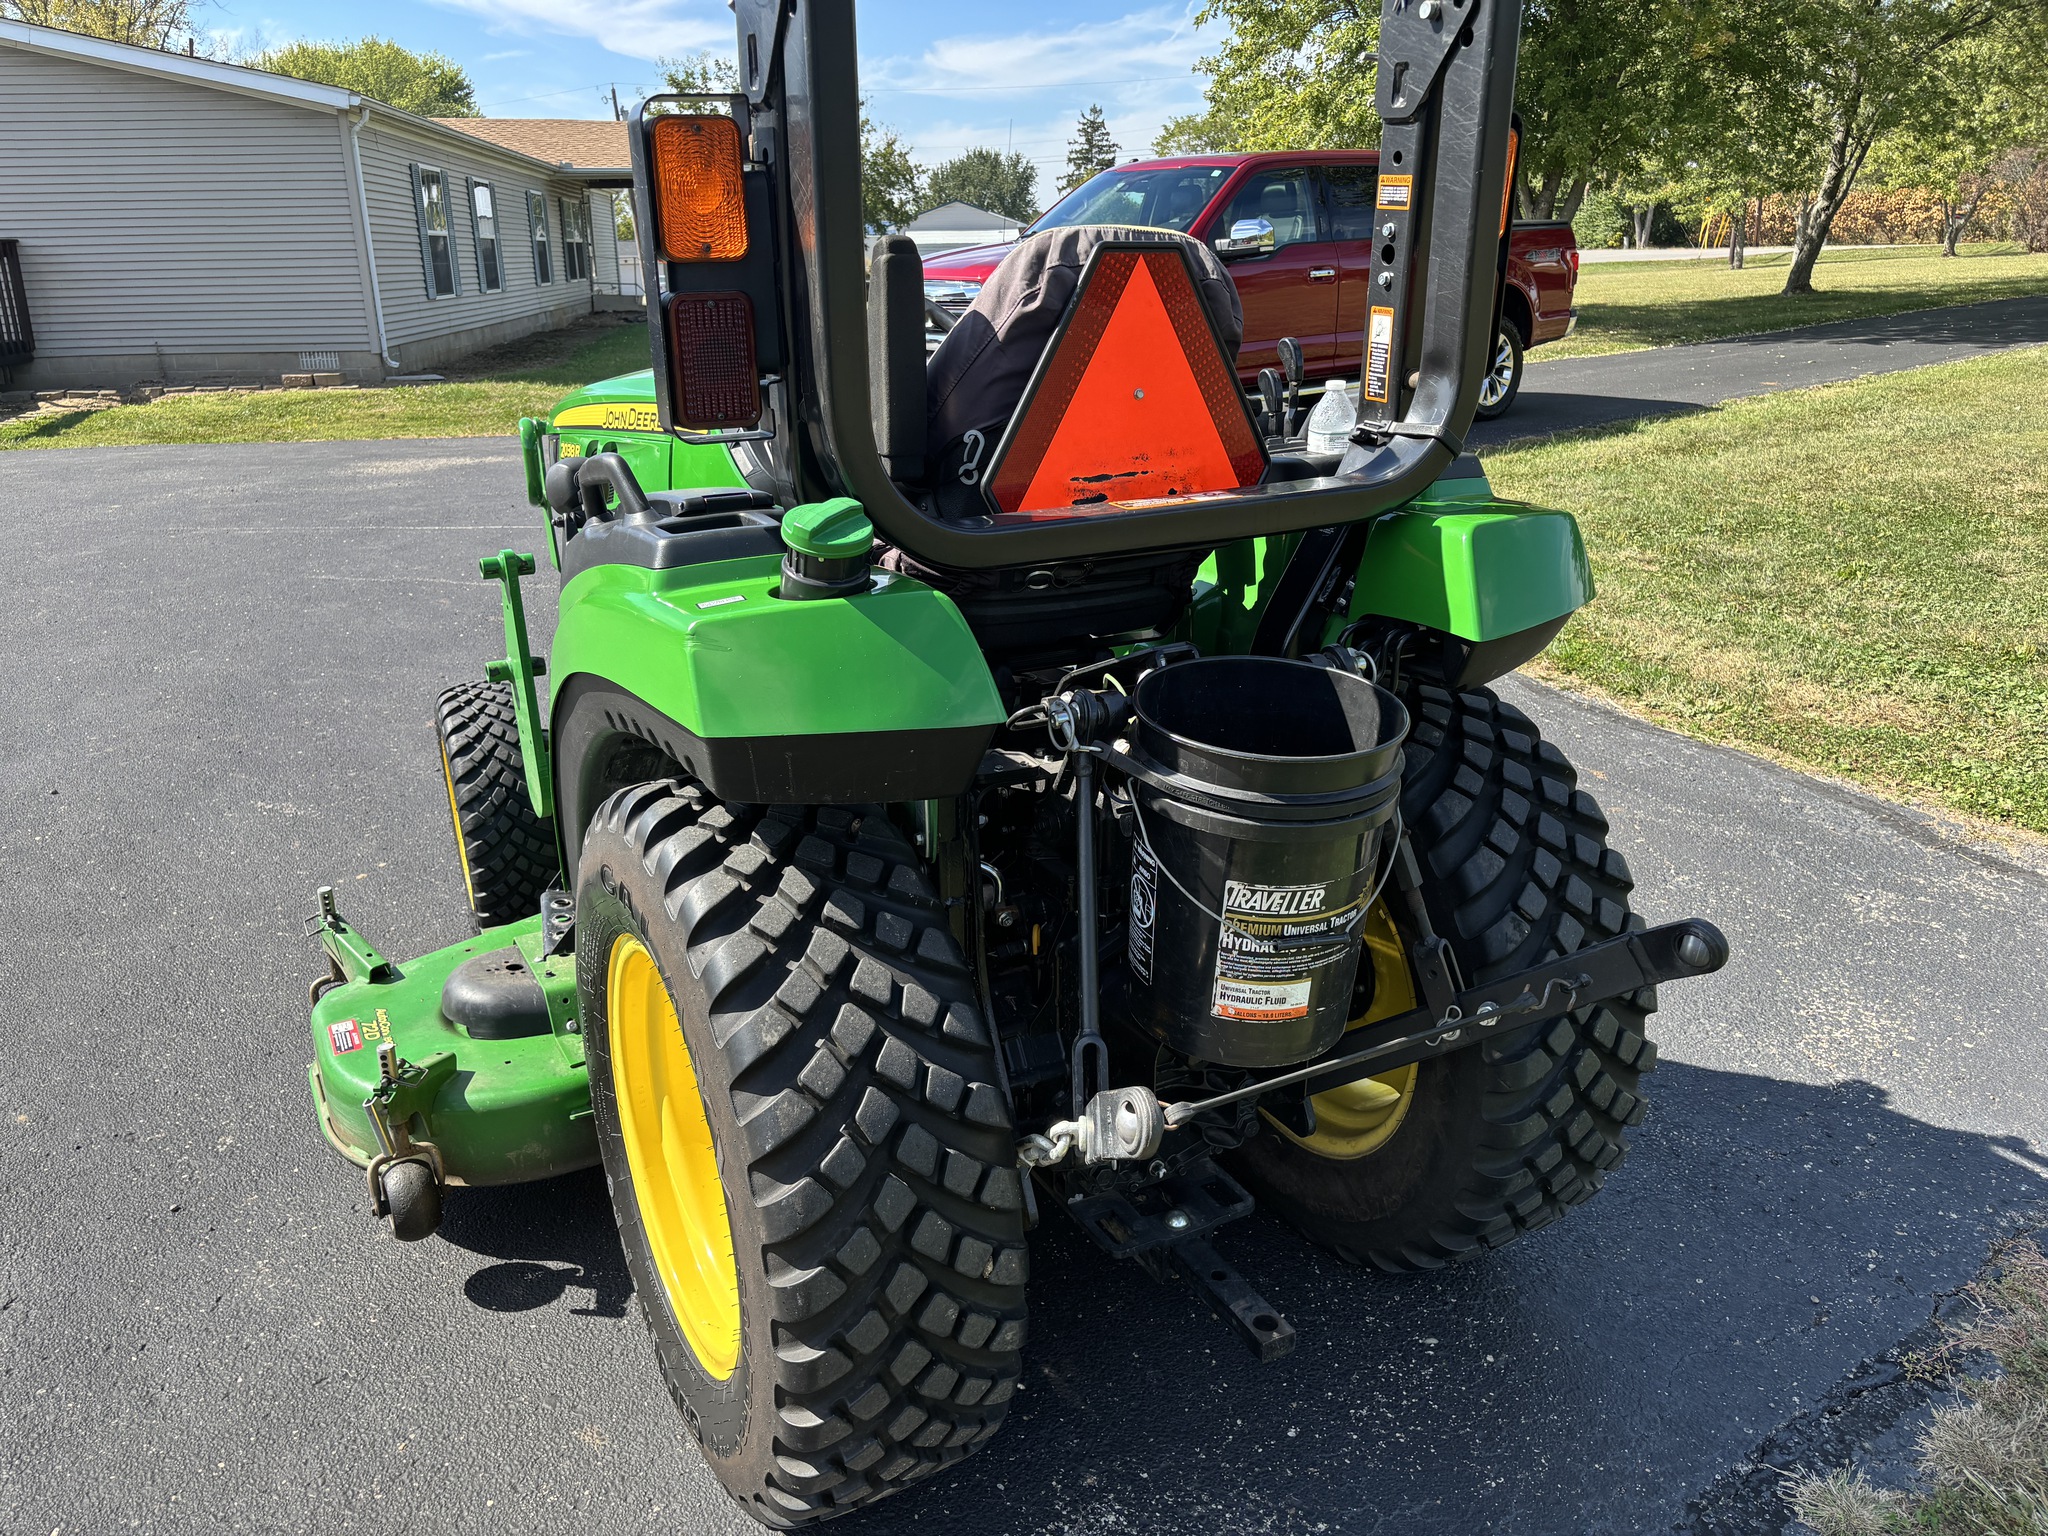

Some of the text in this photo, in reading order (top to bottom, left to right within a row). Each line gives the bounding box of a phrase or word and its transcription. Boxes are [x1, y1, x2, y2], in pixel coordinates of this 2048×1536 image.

[1385, 176, 1411, 184] WARNING
[602, 407, 628, 427] JOHN
[1226, 885, 1326, 915] TRAVELLER
[1283, 921, 1329, 936] UNIVERSAL
[1220, 983, 1271, 996] UNIVERSAL TRACTOR
[1219, 991, 1263, 1005] HYDRAULIC
[1264, 996, 1287, 1006] FLUID
